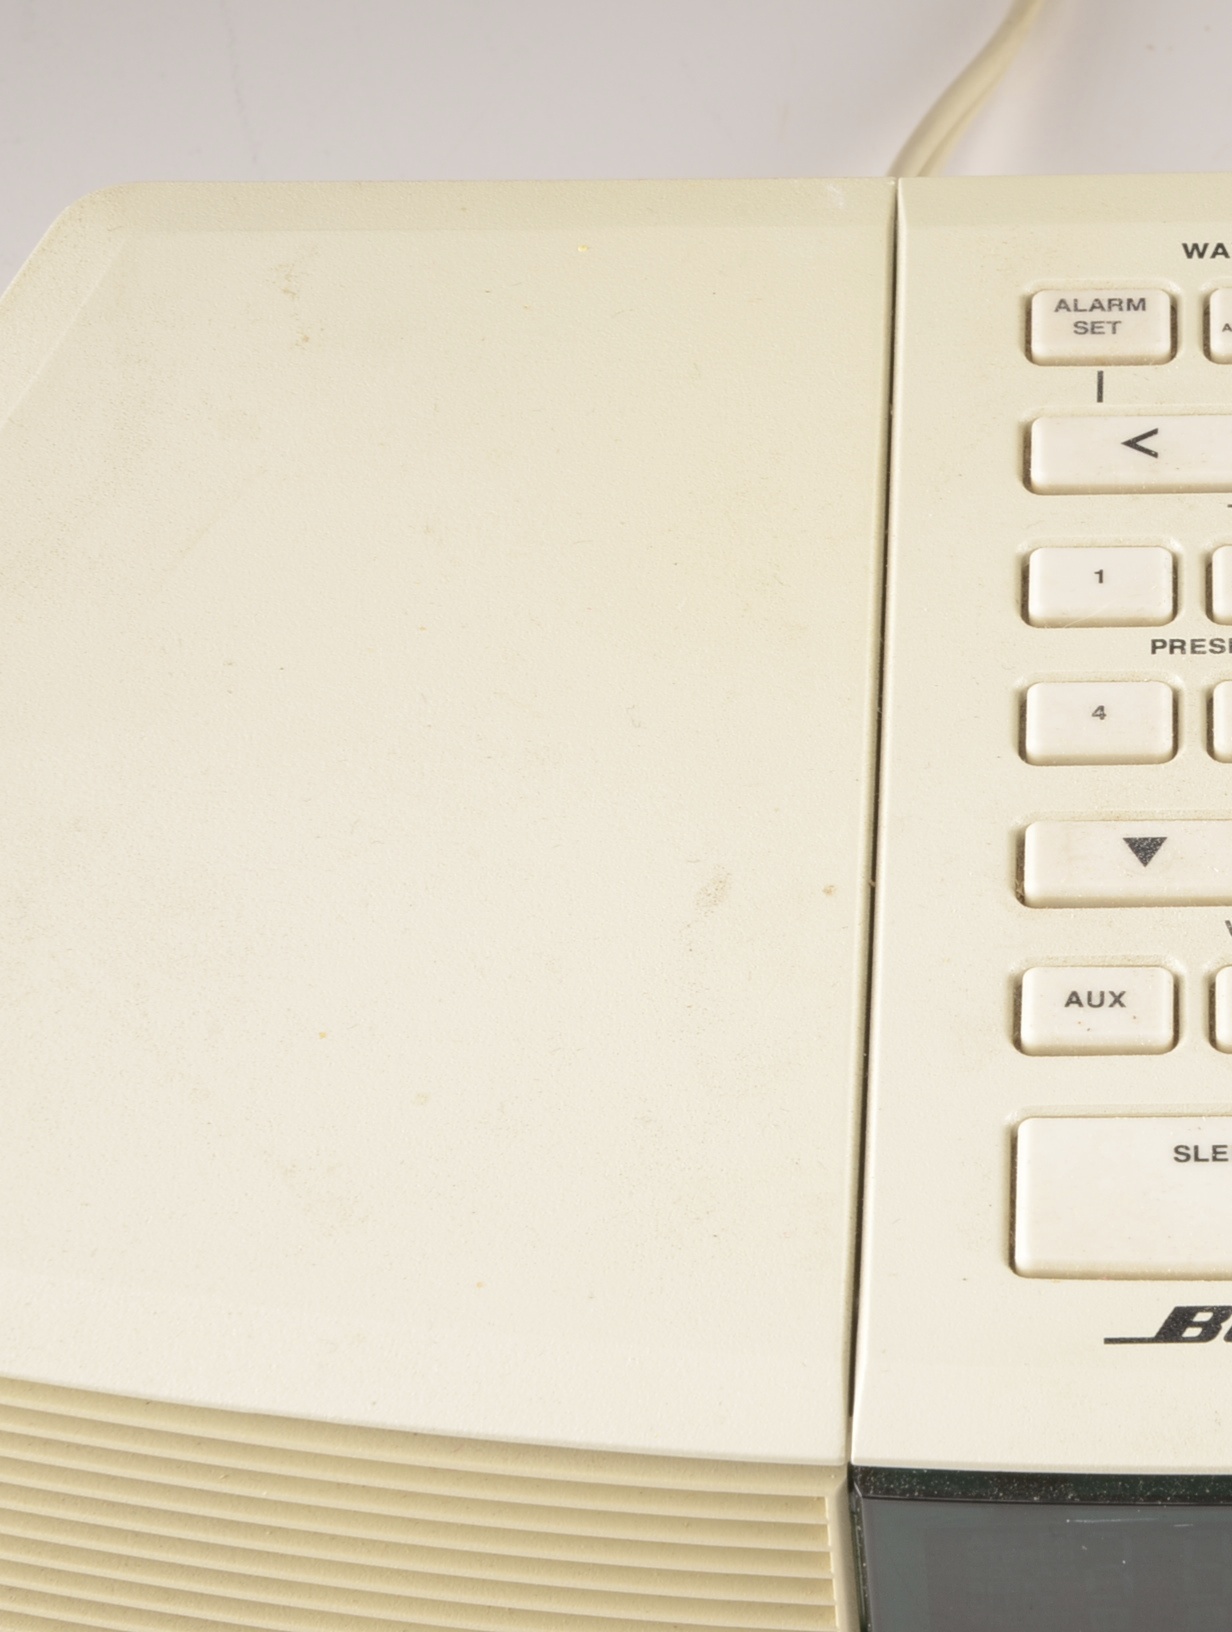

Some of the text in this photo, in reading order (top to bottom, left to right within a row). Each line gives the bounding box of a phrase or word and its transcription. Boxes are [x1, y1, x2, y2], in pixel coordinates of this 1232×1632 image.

[1054, 297, 1147, 313] ALARM
[1073, 320, 1122, 336] SET
[1094, 569, 1104, 584] 1
[1091, 705, 1107, 721] 4
[1064, 990, 1127, 1009] AUX
